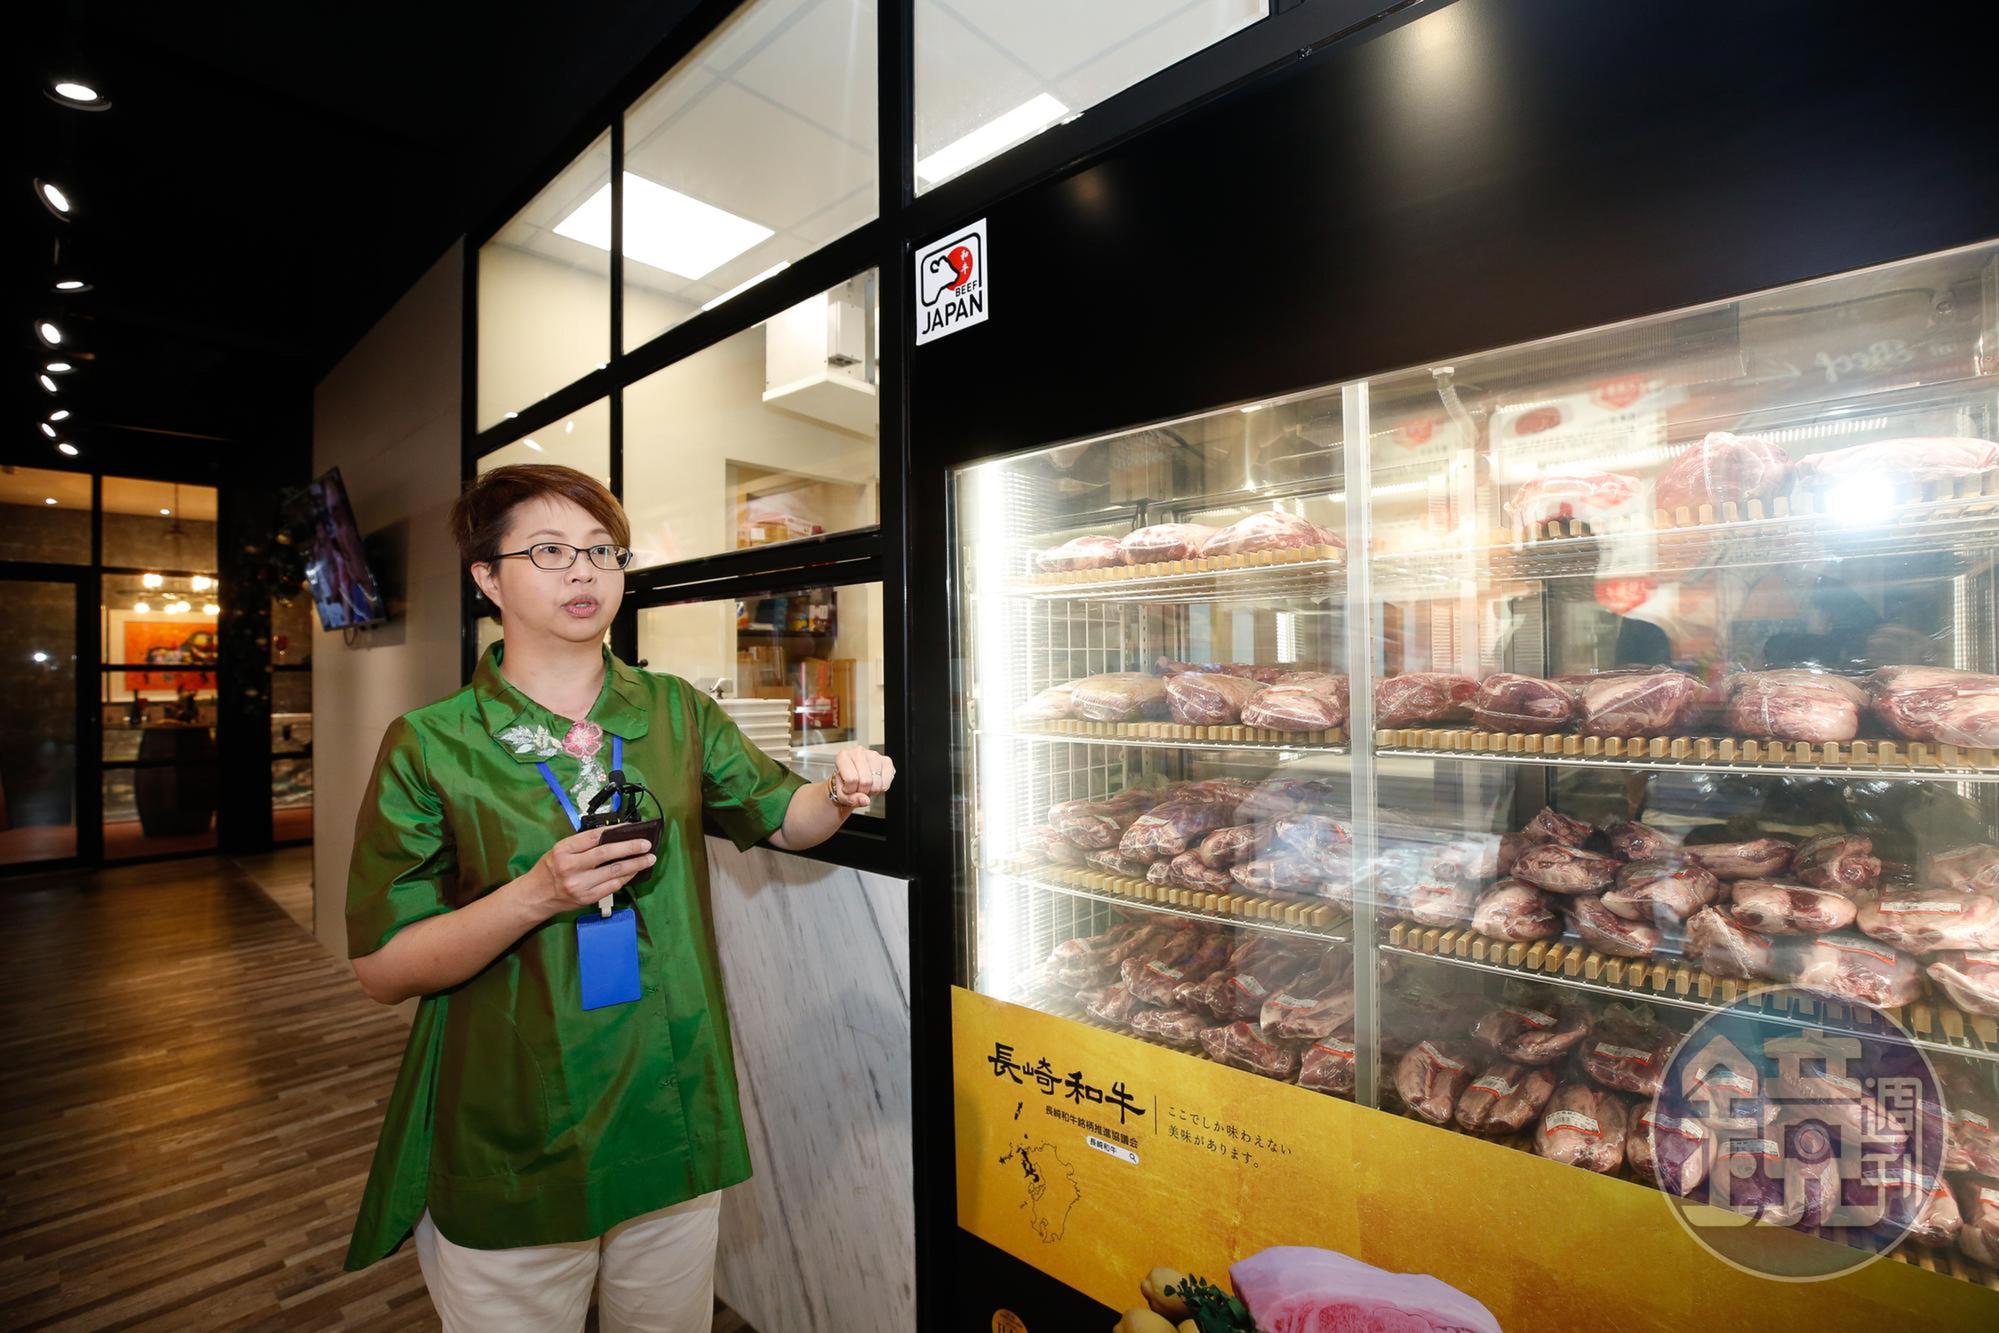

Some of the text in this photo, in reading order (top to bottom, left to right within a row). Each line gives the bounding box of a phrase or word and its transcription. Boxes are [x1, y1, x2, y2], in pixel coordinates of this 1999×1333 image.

[955, 280, 978, 298] BEEF
[922, 290, 983, 335] JAPAN
[988, 1042, 1146, 1125] 長崎和牛
[1168, 1106, 1292, 1155] ここでしか味わえない
[1168, 1124, 1261, 1169] 美味があります。
